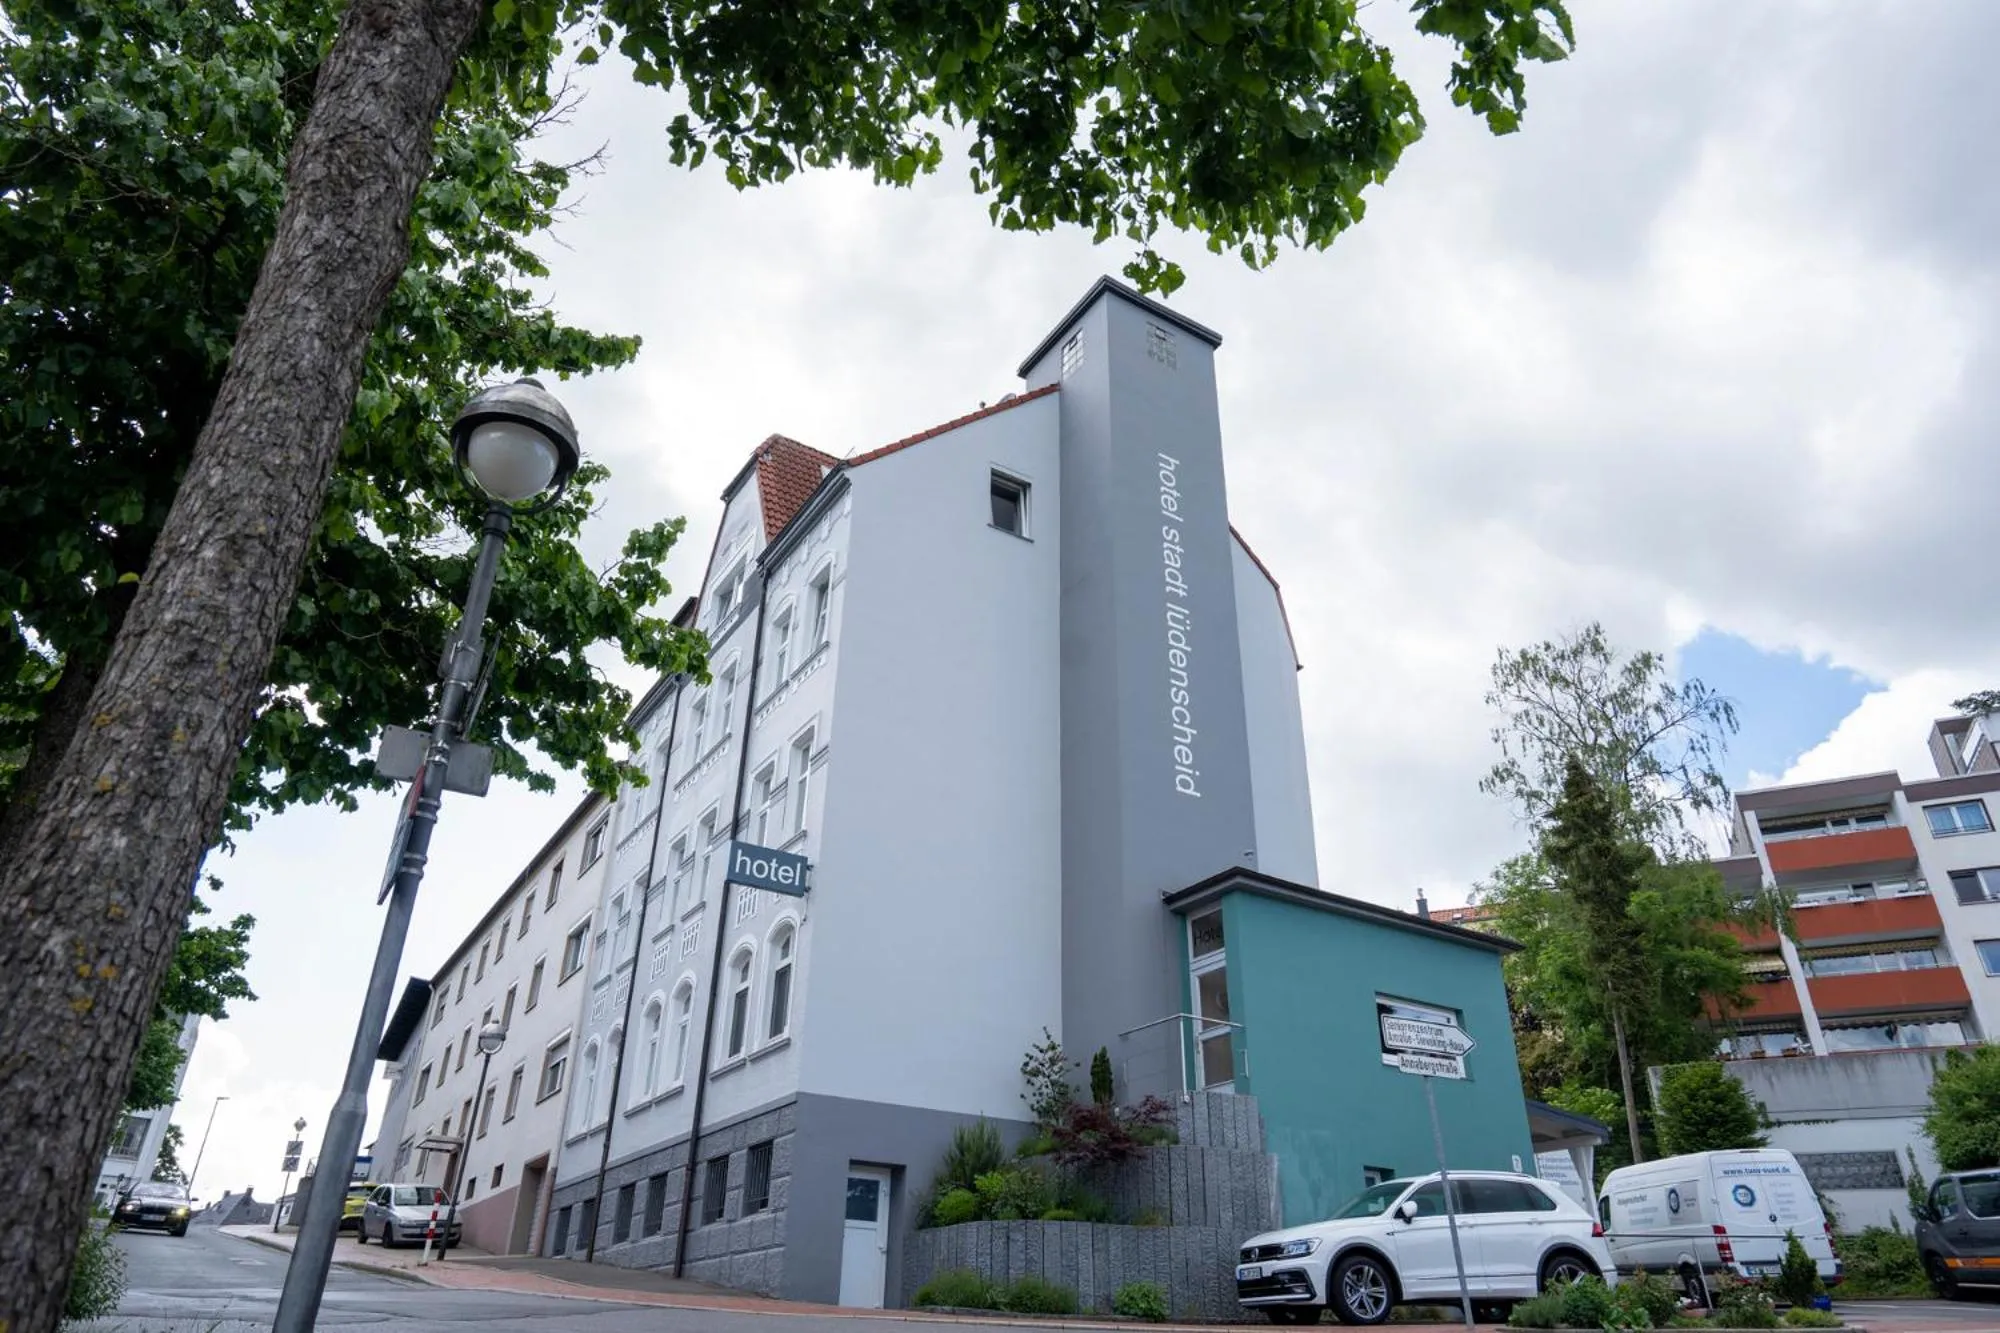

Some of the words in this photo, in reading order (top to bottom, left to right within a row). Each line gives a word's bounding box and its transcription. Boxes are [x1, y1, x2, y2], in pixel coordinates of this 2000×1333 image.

[1158, 453, 1184, 522] hotel
[1162, 526, 1188, 597] stadt
[1166, 602, 1201, 797] lüdenscheid
[735, 849, 801, 886] hotel
